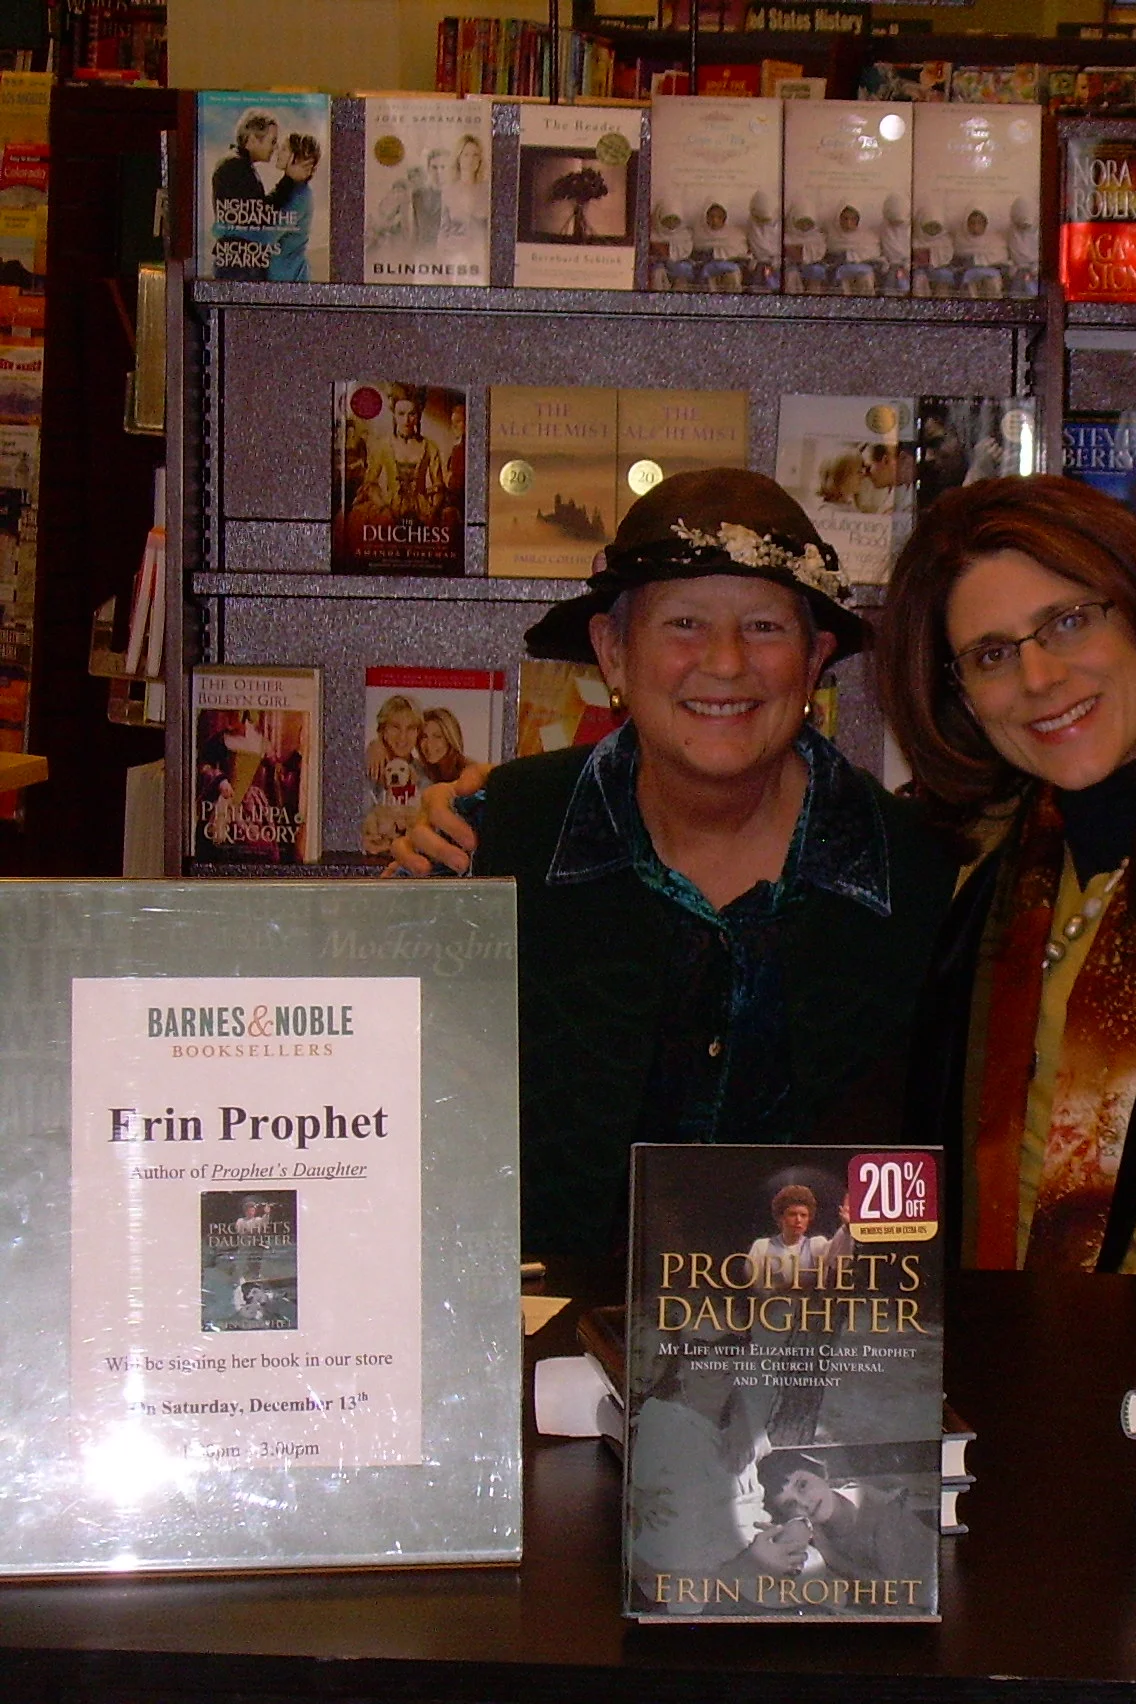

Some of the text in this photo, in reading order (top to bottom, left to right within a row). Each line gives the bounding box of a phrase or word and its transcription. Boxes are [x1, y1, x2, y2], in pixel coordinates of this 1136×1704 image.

[544, 118, 569, 131] The
[1072, 158, 1132, 188] NORA
[216, 198, 264, 212] NIGHTS
[216, 210, 298, 226] RODANTHE
[216, 241, 281, 256] NICHOLAS
[215, 253, 270, 268] SPARKS
[373, 262, 481, 276] BLINDNESS
[498, 422, 609, 439] ALCHEMIST
[625, 425, 737, 441] ALCHEMIST
[1062, 446, 1135, 470] BERRY
[509, 469, 527, 484] 20
[361, 524, 451, 545] DUCHESS
[200, 677, 284, 693] THE OTHER
[198, 693, 254, 707] BOLEYN
[200, 800, 290, 826] PHILIPPA
[202, 823, 302, 845] GREGORY
[171, 1043, 334, 1059] BOOKSELLERS
[107, 1105, 389, 1151] Erin Prophet
[131, 1163, 197, 1180] Author
[199, 1163, 209, 1179] of
[292, 1160, 368, 1181] Daughter
[904, 1199, 926, 1219] OFF
[207, 1234, 293, 1249] DAUGHTER
[659, 1251, 921, 1293] PROPHET'S
[656, 1294, 929, 1336] DAUGHTER
[145, 1352, 394, 1374] be signing her book in our store
[162, 1391, 370, 1418] Saturday, December 13th
[655, 1573, 923, 1606] ERIN PROPHET
